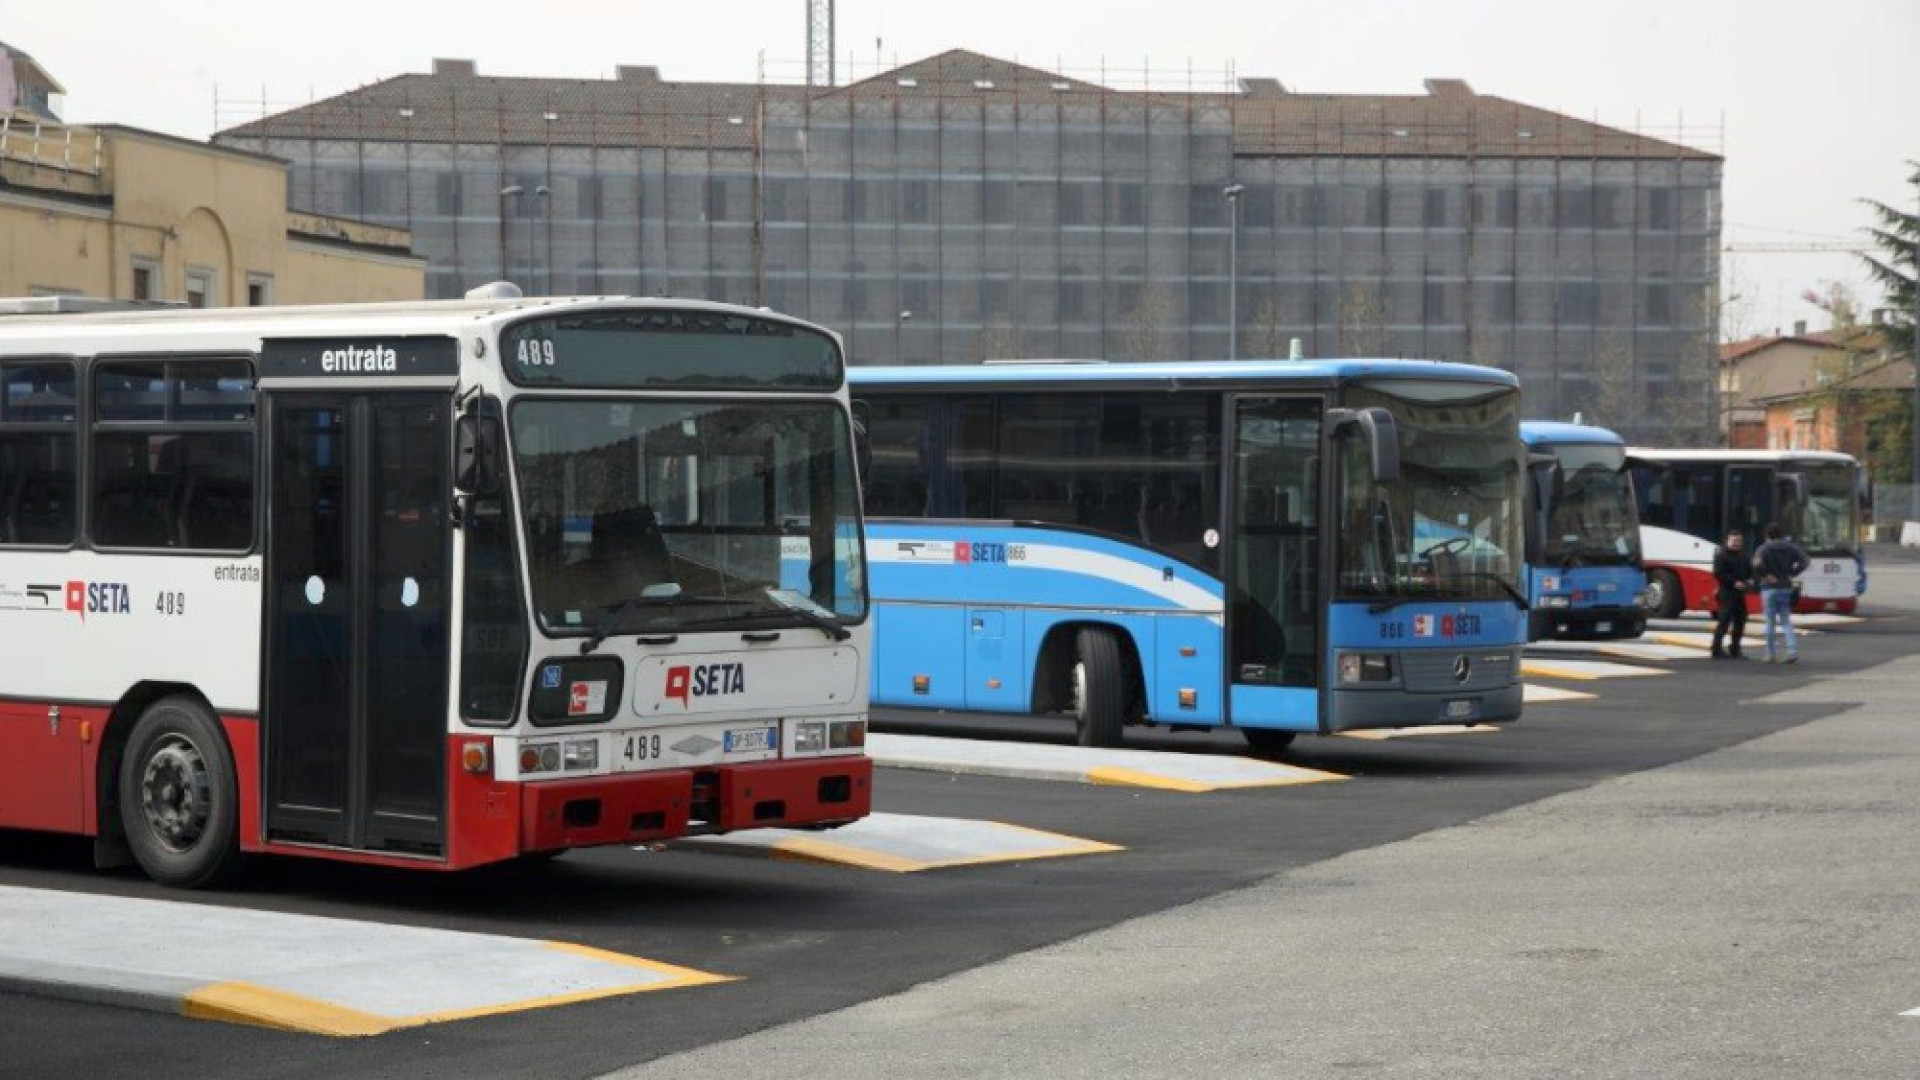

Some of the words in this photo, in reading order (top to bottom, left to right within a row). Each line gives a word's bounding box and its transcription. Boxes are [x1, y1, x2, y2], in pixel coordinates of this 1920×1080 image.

[322, 344, 397, 371] entrata
[517, 339, 555, 366] 489
[972, 542, 1006, 562] SETA
[214, 564, 261, 582] entrata
[87, 582, 131, 614] SETA
[155, 590, 185, 615] 489
[692, 663, 745, 697] SETA
[623, 734, 661, 761] 489
